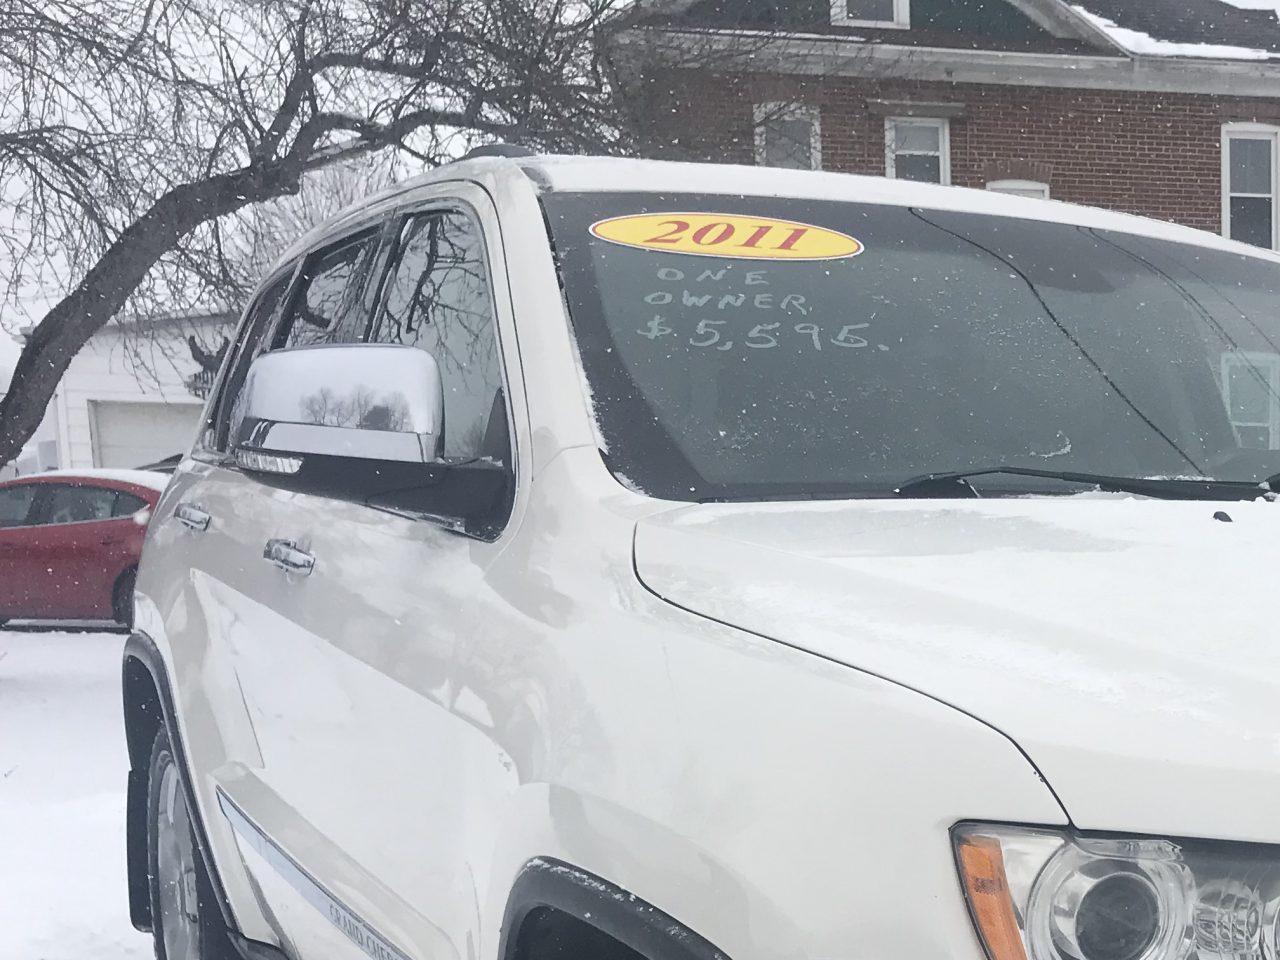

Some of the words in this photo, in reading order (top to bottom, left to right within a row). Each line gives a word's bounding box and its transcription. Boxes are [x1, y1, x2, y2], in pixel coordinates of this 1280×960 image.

[643, 220, 809, 251] 2011
[656, 268, 770, 285] ONE
[644, 290, 808, 315] OWNER
